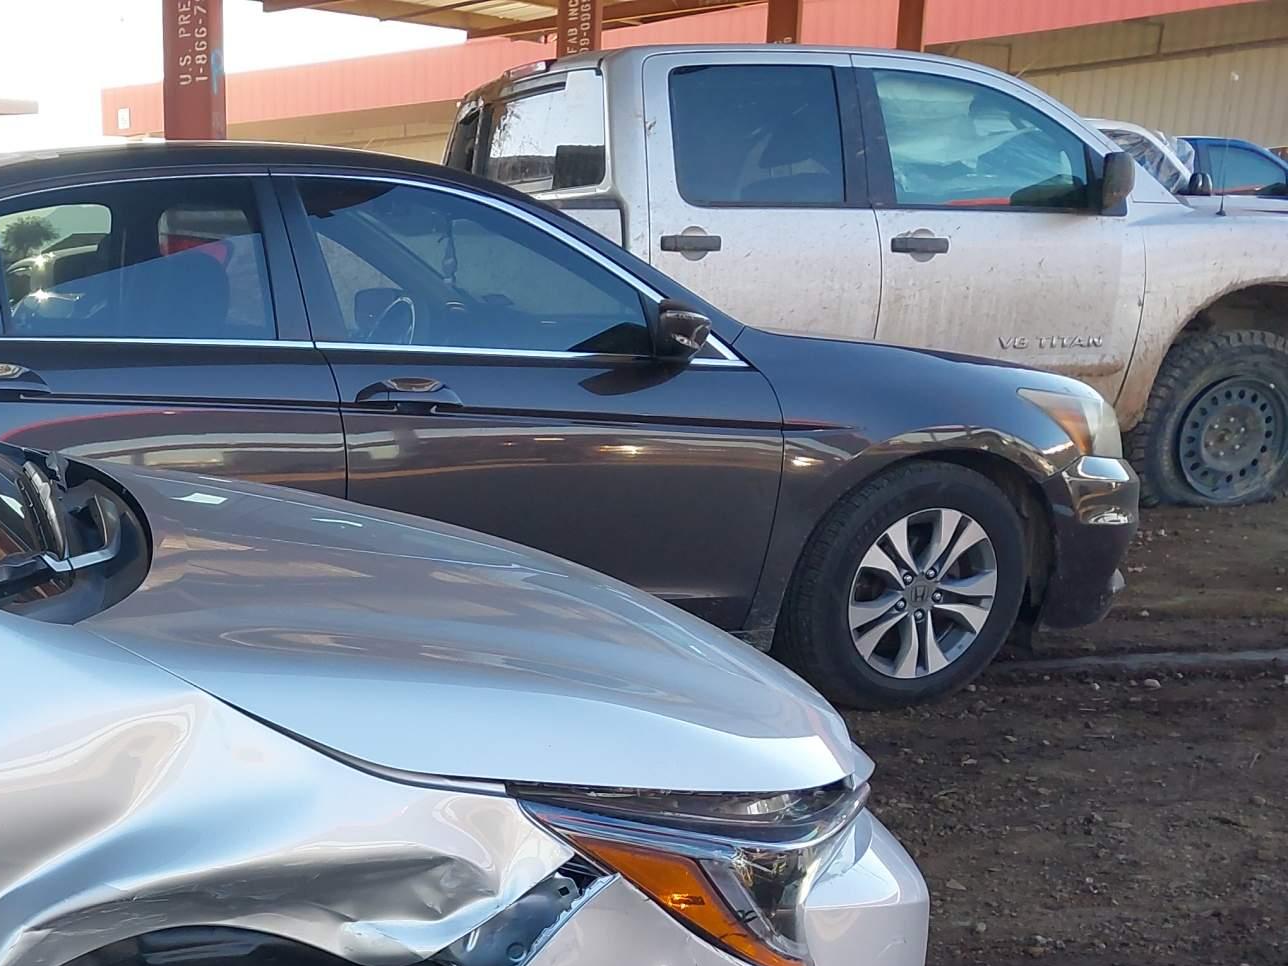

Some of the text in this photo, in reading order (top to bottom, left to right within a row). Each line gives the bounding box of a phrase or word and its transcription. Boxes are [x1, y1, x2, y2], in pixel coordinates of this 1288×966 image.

[194, 0, 209, 82] 1-866-7
[178, 49, 193, 86] U.S.
[998, 335, 1105, 350] V8 TITAN
